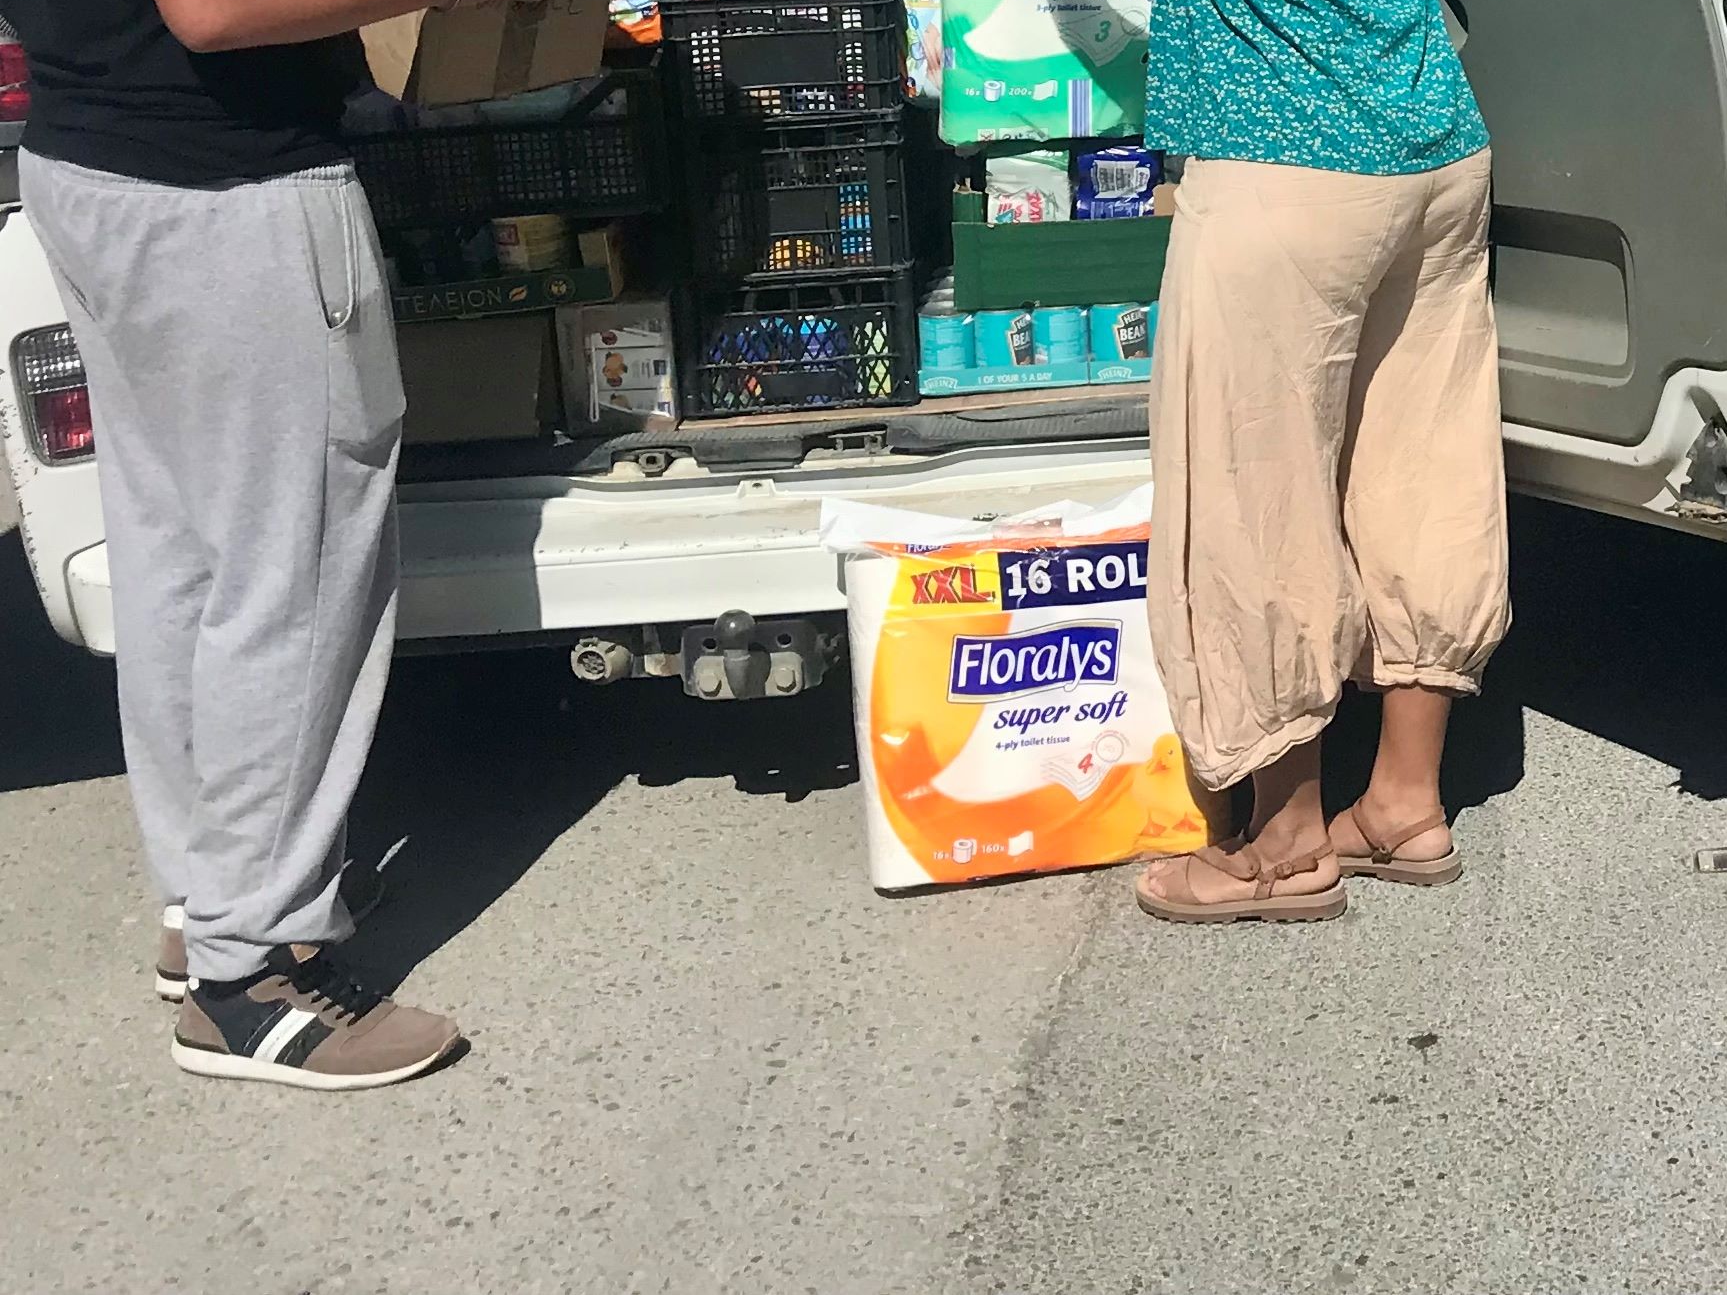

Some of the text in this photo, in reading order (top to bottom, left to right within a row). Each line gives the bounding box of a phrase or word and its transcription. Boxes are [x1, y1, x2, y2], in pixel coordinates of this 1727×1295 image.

[1094, 19, 1112, 43] 3
[983, 375, 995, 384] OF
[996, 374, 1019, 383] YOUR
[1036, 372, 1053, 381] DAY
[1005, 559, 1054, 598] 16
[1067, 554, 1148, 593] ROL
[957, 635, 1113, 693] Floralys
[993, 690, 1129, 735] super soft
[995, 735, 1071, 751] 4-ply toilet tissue
[1077, 753, 1094, 774] 4
